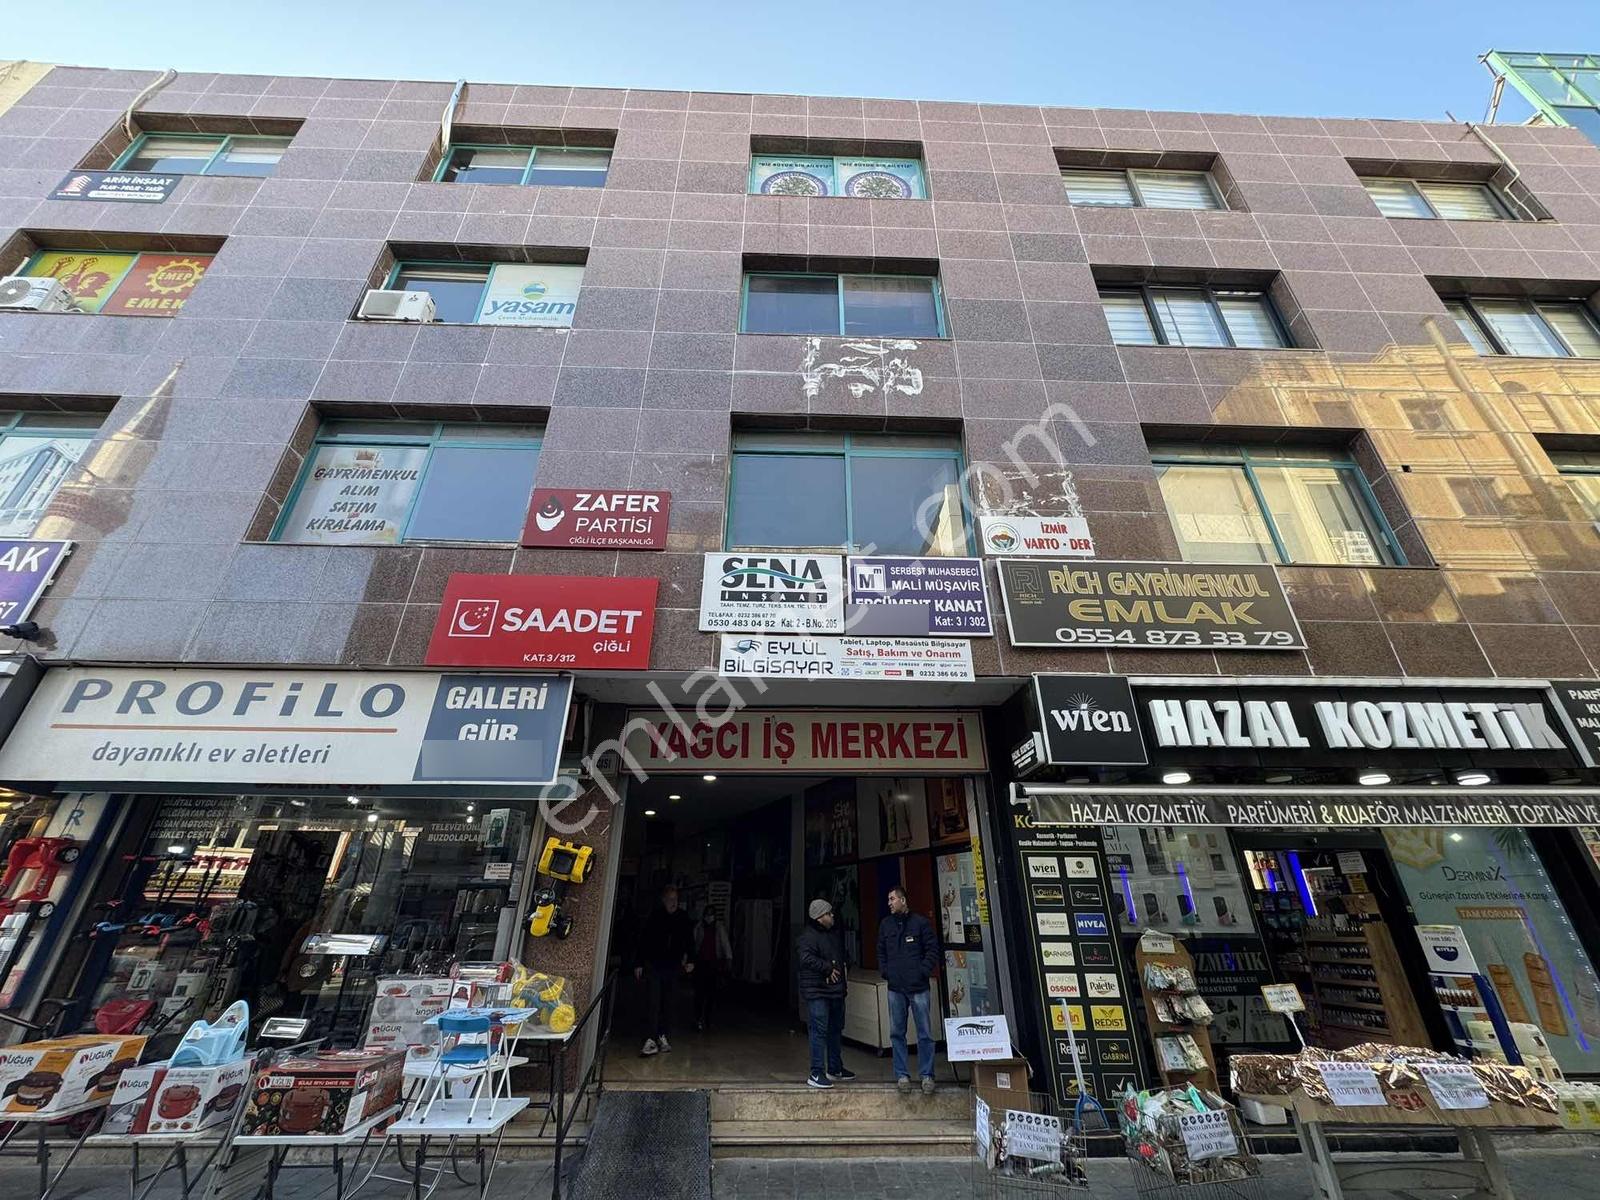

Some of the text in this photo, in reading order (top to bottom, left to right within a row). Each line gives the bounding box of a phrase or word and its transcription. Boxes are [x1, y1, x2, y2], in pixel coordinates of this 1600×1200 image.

[484, 300, 576, 316] yaşam
[314, 467, 419, 481] GAYRİMENKUL
[339, 485, 381, 497] ALIM
[329, 501, 378, 514] SATIM
[572, 493, 660, 513] ZAFER
[305, 516, 387, 532] KİRALAMA
[575, 516, 652, 534] PARTİSİ
[1040, 521, 1068, 535] İZMİR
[569, 536, 654, 547] ÇİĞLİ İLÇE BAŞKANLIĞI
[1023, 538, 1093, 551] VARTO DER
[721, 557, 828, 590] SENA
[890, 566, 979, 577] SERBEST MUHASEBECİ
[891, 579, 981, 593] MALİ MÜŞAVİR
[1048, 564, 1271, 598] RİCH GAYRİMENKUL
[934, 599, 983, 613] KANAT
[1068, 599, 1263, 626] EMLAK
[500, 607, 643, 634] SAADET
[707, 619, 730, 627] 0530
[732, 619, 749, 627] 483
[825, 619, 838, 629] 205
[934, 615, 954, 627] Kat:
[956, 617, 962, 627] 3
[969, 617, 987, 627] 302
[839, 638, 967, 648] Tablet, Laptop, Masaüstü Bilgisayar
[1055, 627, 1295, 647] 0554 873 33 79
[592, 639, 631, 653] ÇİĞLİ
[767, 639, 827, 656] EYLÜL
[846, 648, 875, 658] Satış,
[877, 648, 909, 658] Bakım
[925, 649, 961, 659] Onarım
[724, 656, 834, 675] BİLGİSAYAR
[445, 683, 549, 710] GALERİ
[1050, 702, 1132, 733] wien
[1148, 699, 1311, 748] HAZAL
[762, 716, 796, 765] İŞ
[811, 717, 969, 760] MERKEZİ
[91, 741, 332, 767] dayanıklı ev aletleri
[1070, 803, 1125, 823] HAZAL
[1125, 799, 1211, 824] KOZMETİK
[1228, 801, 1317, 824] PARFÜMERİ
[1320, 804, 1335, 824] &
[1335, 801, 1403, 825] KUAFÖR
[1403, 800, 1511, 825] MALZEMELERİ
[1509, 804, 1579, 825] TOPTAN
[1032, 864, 1057, 873] wien
[1077, 920, 1106, 929] NIVEA
[1050, 985, 1078, 993] OSSION
[1089, 981, 1116, 992] Palette
[1094, 1018, 1124, 1027] REDIST
[1101, 1052, 1130, 1061] GABRINI
